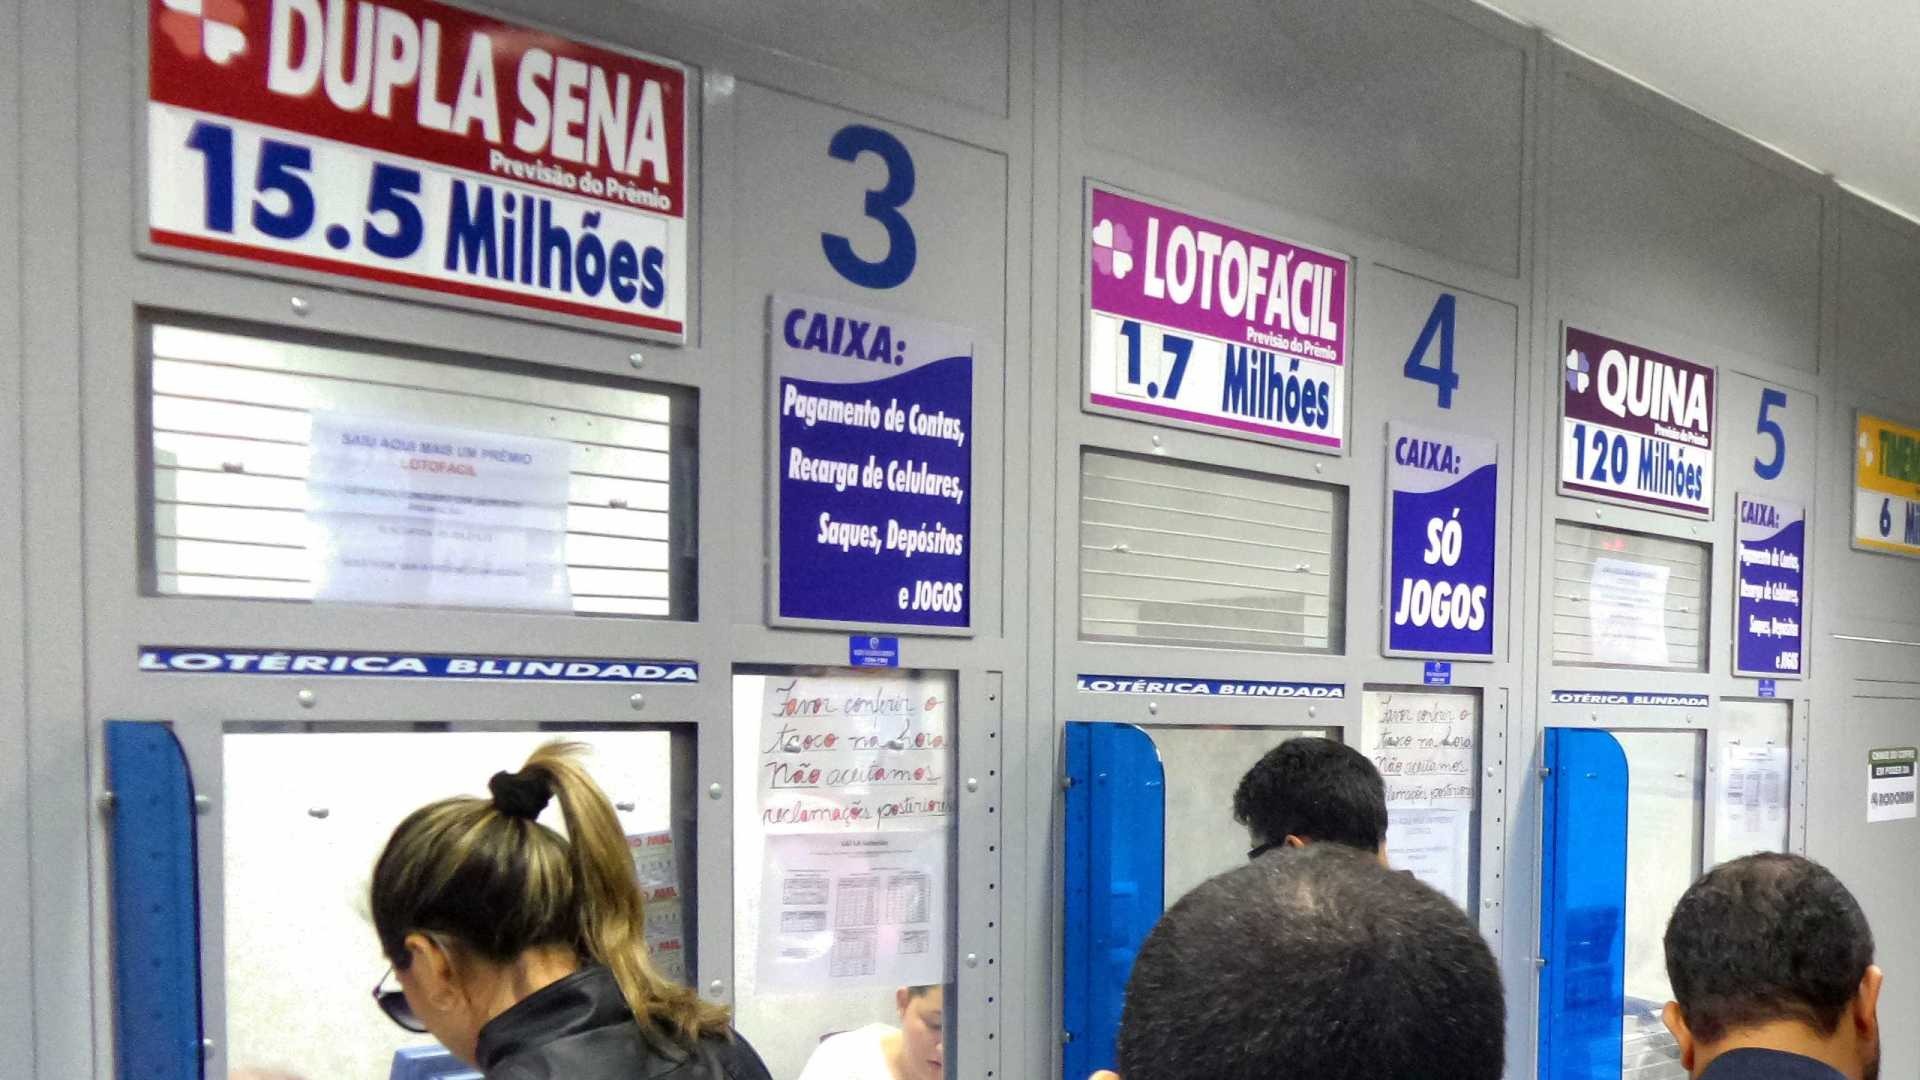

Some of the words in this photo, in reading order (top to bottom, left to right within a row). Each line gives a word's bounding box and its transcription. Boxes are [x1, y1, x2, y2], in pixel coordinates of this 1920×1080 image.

[267, 0, 502, 143] DUPLA
[513, 48, 670, 184] SENA
[490, 149, 577, 189] Previsão
[580, 171, 604, 194] do
[606, 176, 671, 210] Prêmio
[821, 124, 917, 289] 3
[185, 119, 425, 259] 15.5
[445, 179, 665, 309] Milhões
[1143, 217, 1337, 341] LOTOFÁCIL
[783, 308, 906, 366] CAIXA:
[1247, 326, 1290, 350] Previsão
[1290, 337, 1303, 352] do
[1403, 293, 1459, 410] 4
[1120, 319, 1193, 400] 1.7
[1222, 343, 1330, 430] Milhões
[1597, 350, 1708, 432] QUINA
[783, 384, 880, 429] Pagamento
[884, 398, 905, 432] de
[909, 404, 964, 447] Contas,
[1753, 388, 1787, 481] 5
[788, 447, 859, 492] Recarga
[862, 455, 883, 489] de
[887, 460, 964, 504] Celulares,
[1396, 437, 1461, 475] CAIXA:
[1572, 423, 1628, 485] 120
[1637, 438, 1702, 501] Milhões
[817, 512, 882, 555] Saques,
[886, 519, 963, 558] Depósitos
[1424, 508, 1462, 566] SÓ
[1741, 501, 1779, 528] CAIXA:
[1879, 498, 1891, 537] 6
[898, 587, 909, 610] e
[912, 580, 963, 613] JOGOS
[1395, 578, 1487, 631] JOGOS
[139, 652, 428, 673] LOTÉRICA
[446, 659, 698, 680] BLINDADA
[1076, 680, 1211, 695] LOTÉRICA
[1219, 683, 1344, 698] BLINDADA
[1550, 693, 1629, 705] LOTÉRICA
[1633, 695, 1708, 707] BLINDADA
